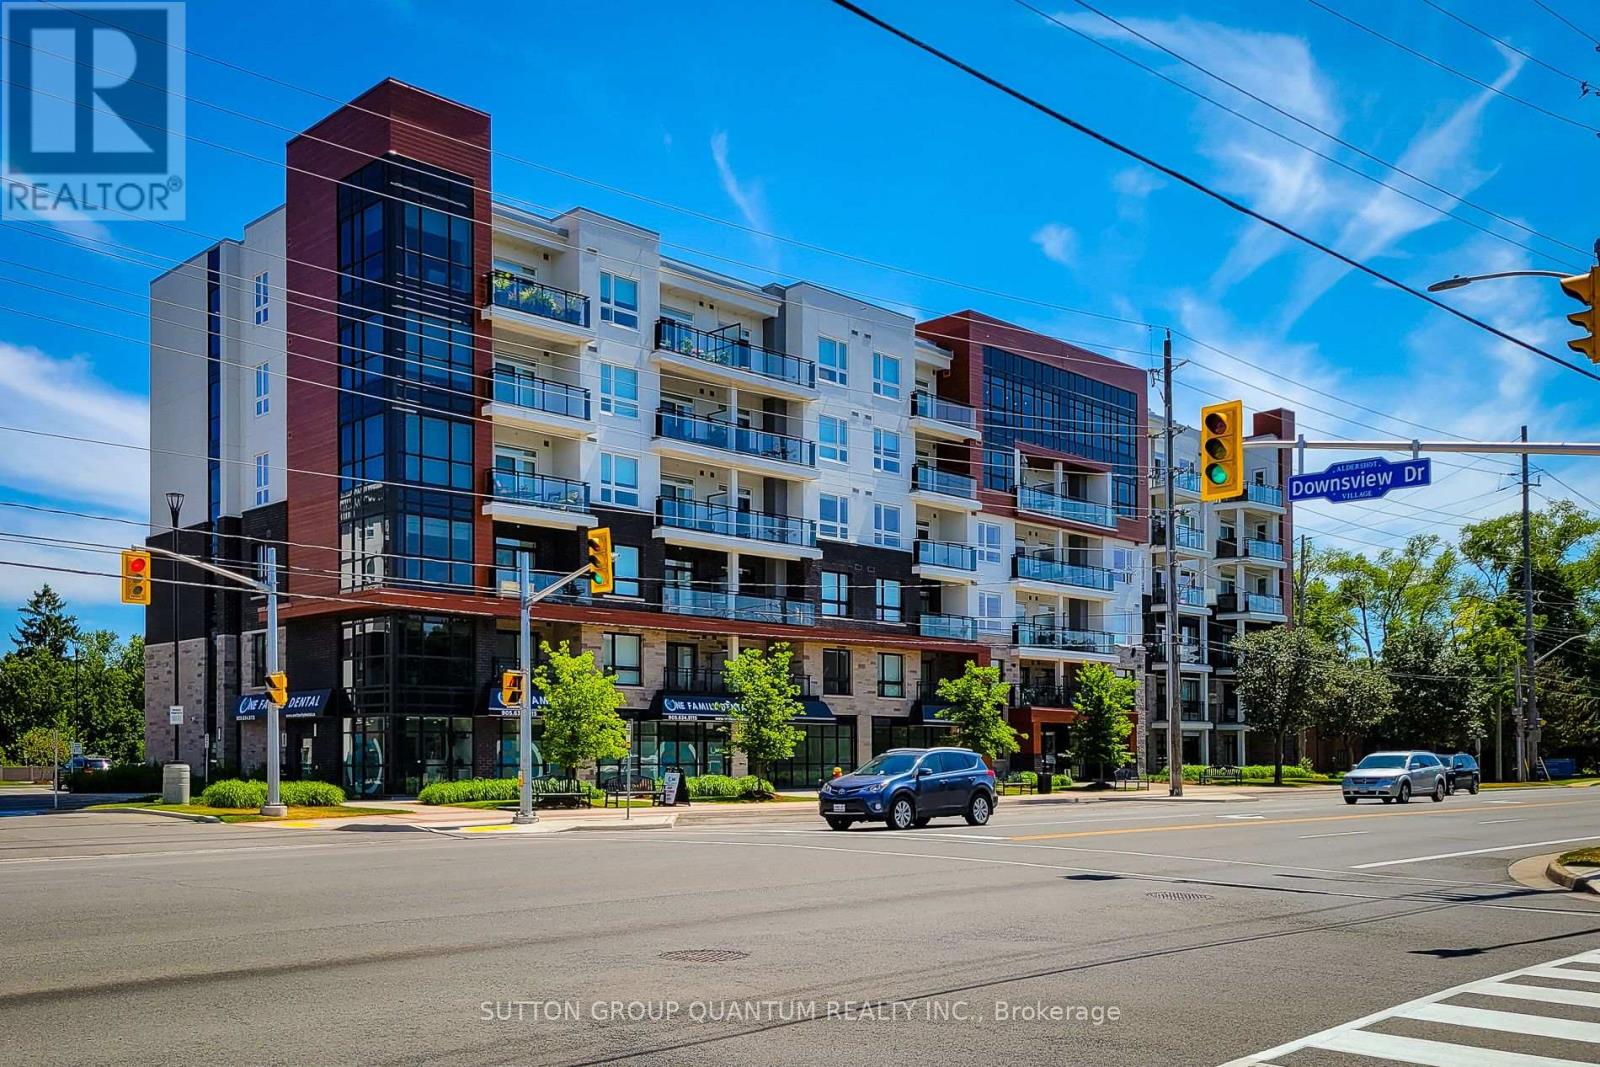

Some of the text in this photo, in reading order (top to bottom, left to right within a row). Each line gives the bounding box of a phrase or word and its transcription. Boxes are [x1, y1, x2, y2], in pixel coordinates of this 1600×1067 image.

[1336, 460, 1378, 472] ALDERSHOT
[1292, 465, 1425, 497] Downsview Dr
[1342, 490, 1373, 500] VILLAGE
[239, 696, 259, 714] ONE
[288, 695, 321, 708] DENTAL
[664, 697, 686, 712] ONE
